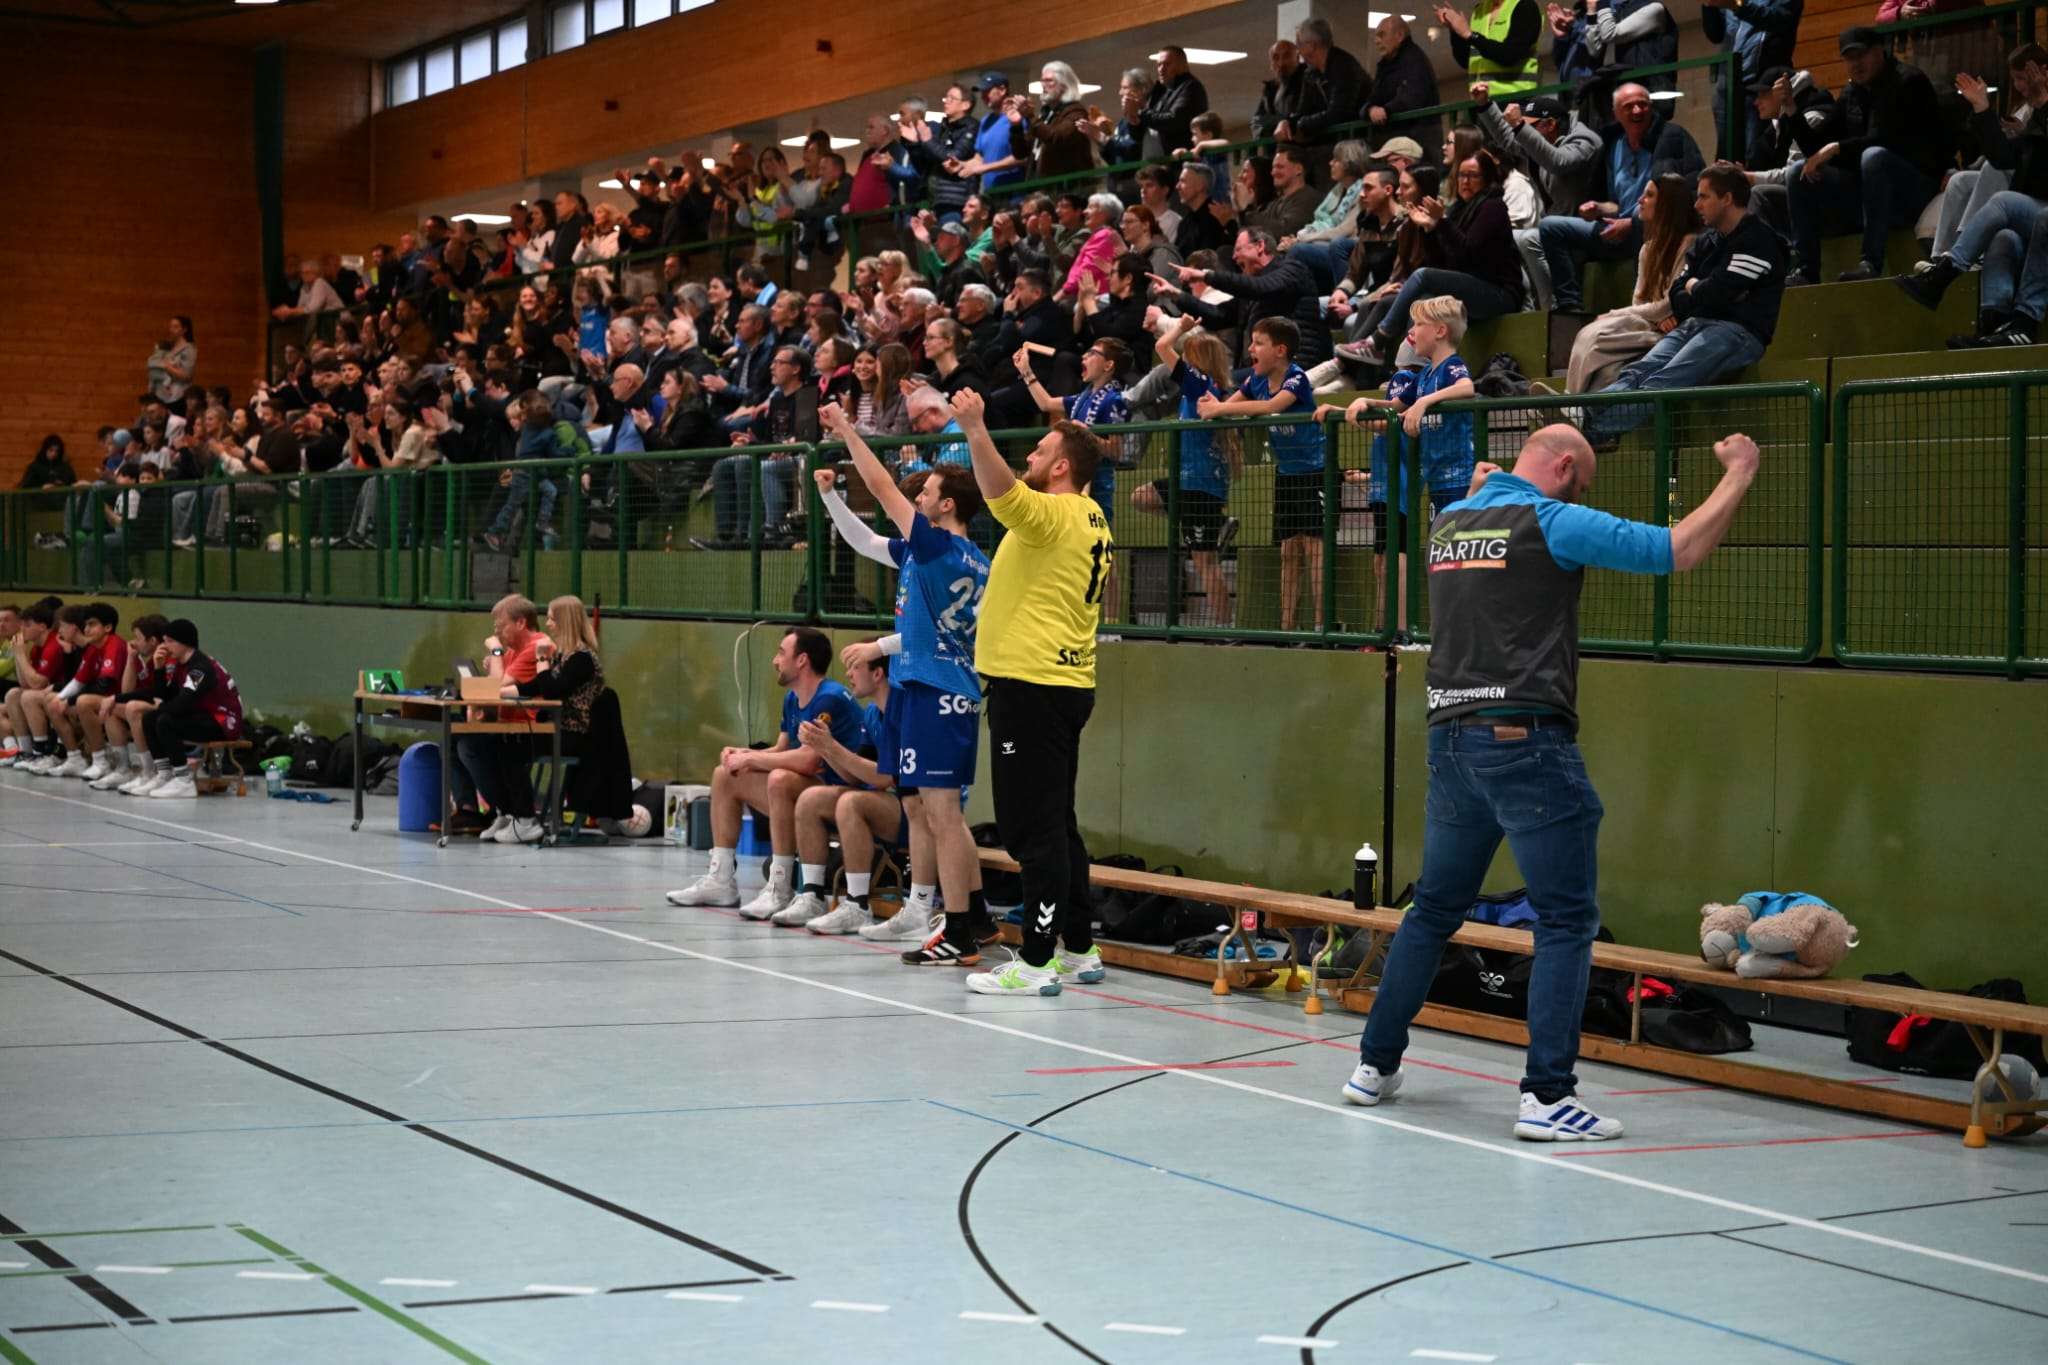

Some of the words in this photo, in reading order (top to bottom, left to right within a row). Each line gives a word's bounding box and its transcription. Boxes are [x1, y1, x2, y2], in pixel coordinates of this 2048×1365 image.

[1429, 539, 1507, 564] HARTIG
[939, 694, 969, 715] SG
[899, 748, 917, 774] 3
